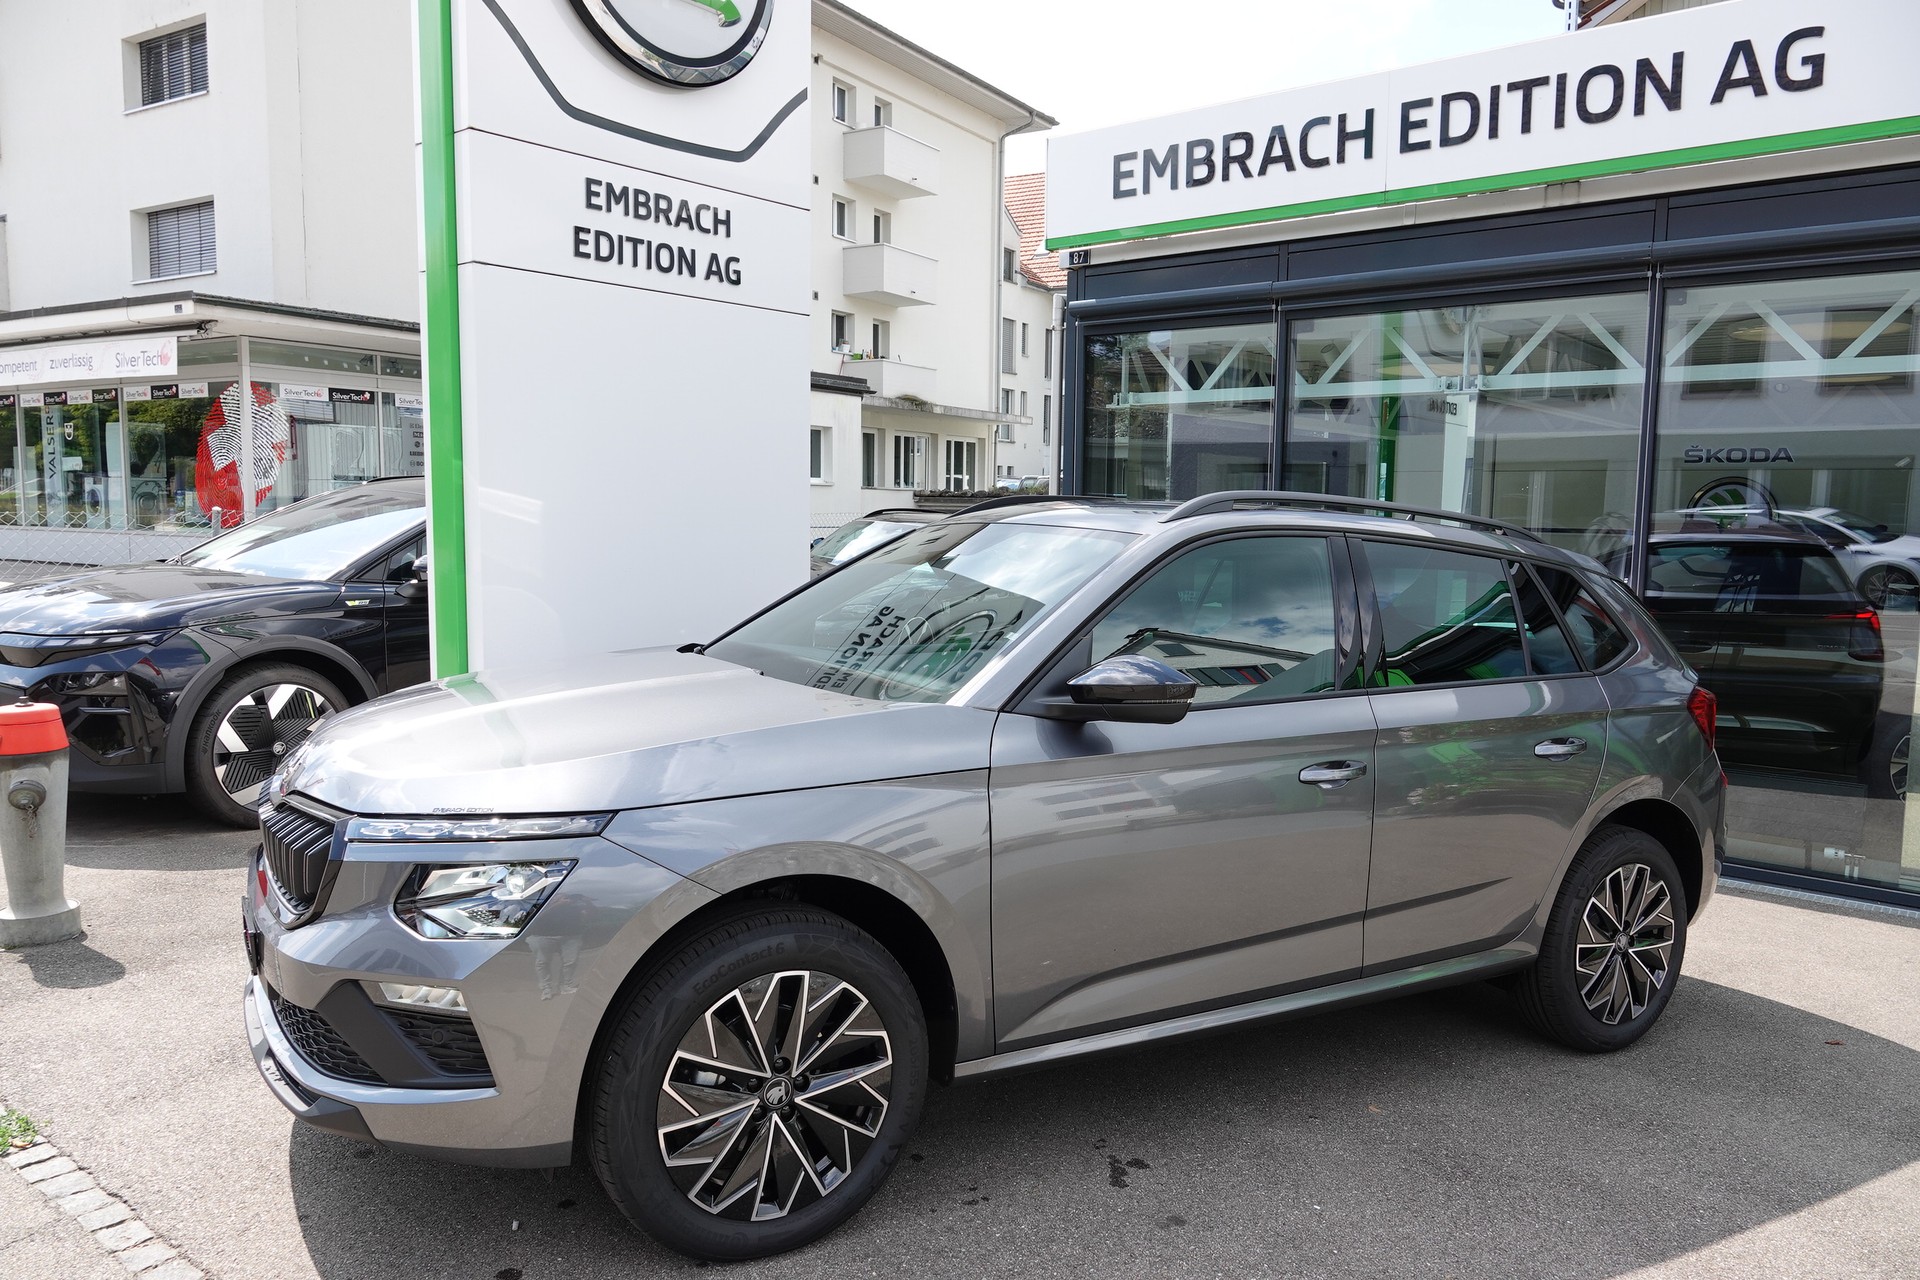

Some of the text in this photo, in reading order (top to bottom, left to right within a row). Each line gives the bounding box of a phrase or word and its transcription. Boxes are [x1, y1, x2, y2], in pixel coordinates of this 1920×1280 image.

[1112, 25, 1826, 200] EMBRACH EDITION AG
[585, 177, 731, 238] EMBRACH
[573, 225, 742, 286] EDITION AG
[1073, 251, 1085, 264] 87
[0, 360, 38, 377] ompetent
[1684, 444, 1795, 464] ŠKODA
